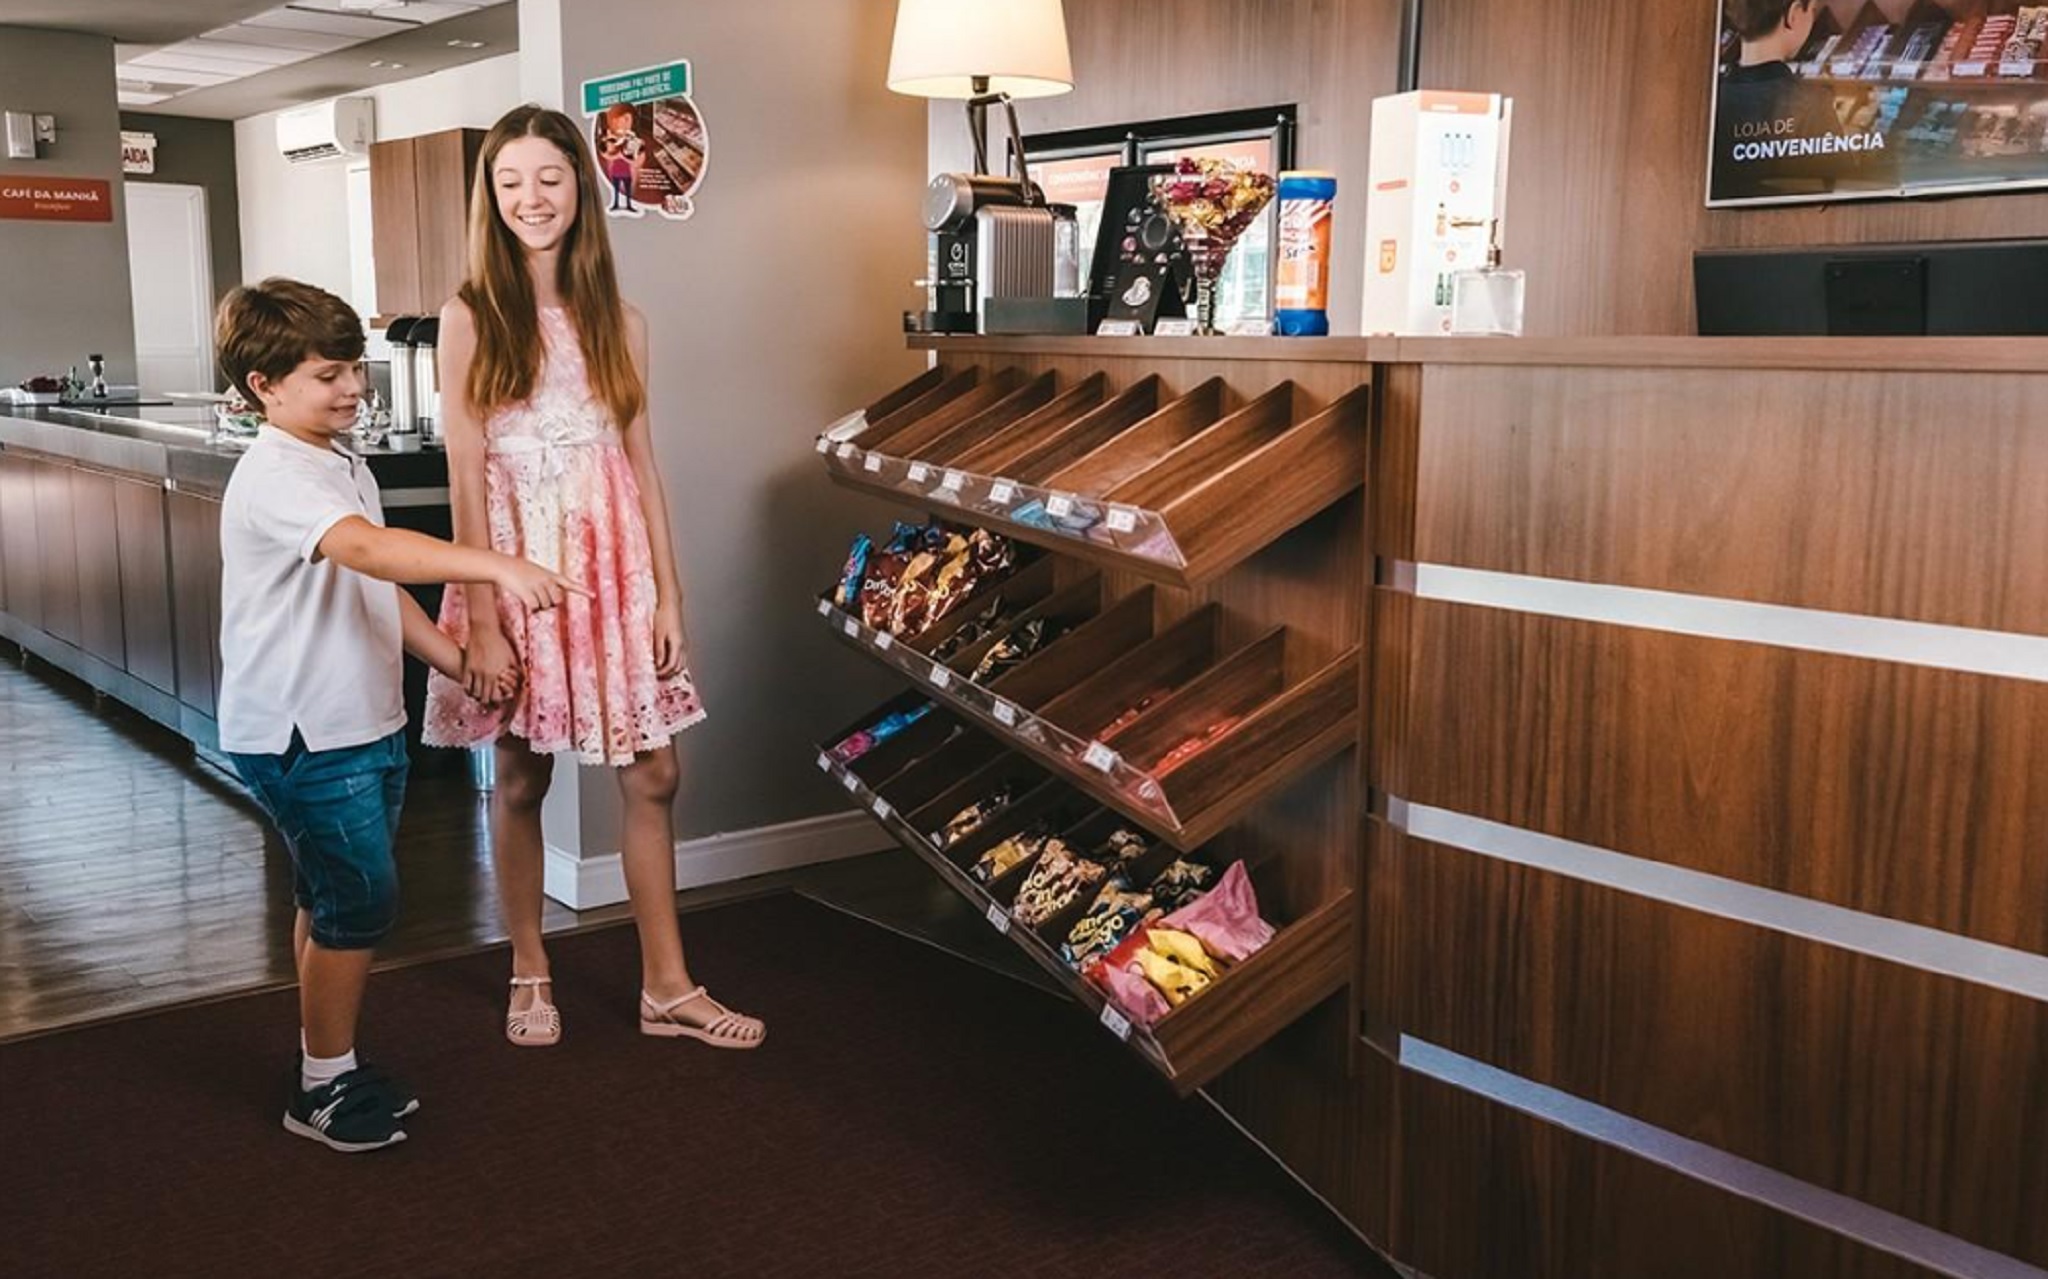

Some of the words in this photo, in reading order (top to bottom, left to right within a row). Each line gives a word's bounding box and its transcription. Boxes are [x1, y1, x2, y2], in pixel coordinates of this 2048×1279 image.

[1734, 121, 1771, 138] LOJA
[1774, 117, 1795, 135] DE
[1733, 131, 1885, 161] CONVENIÊNCIA
[34, 190, 52, 200] DA
